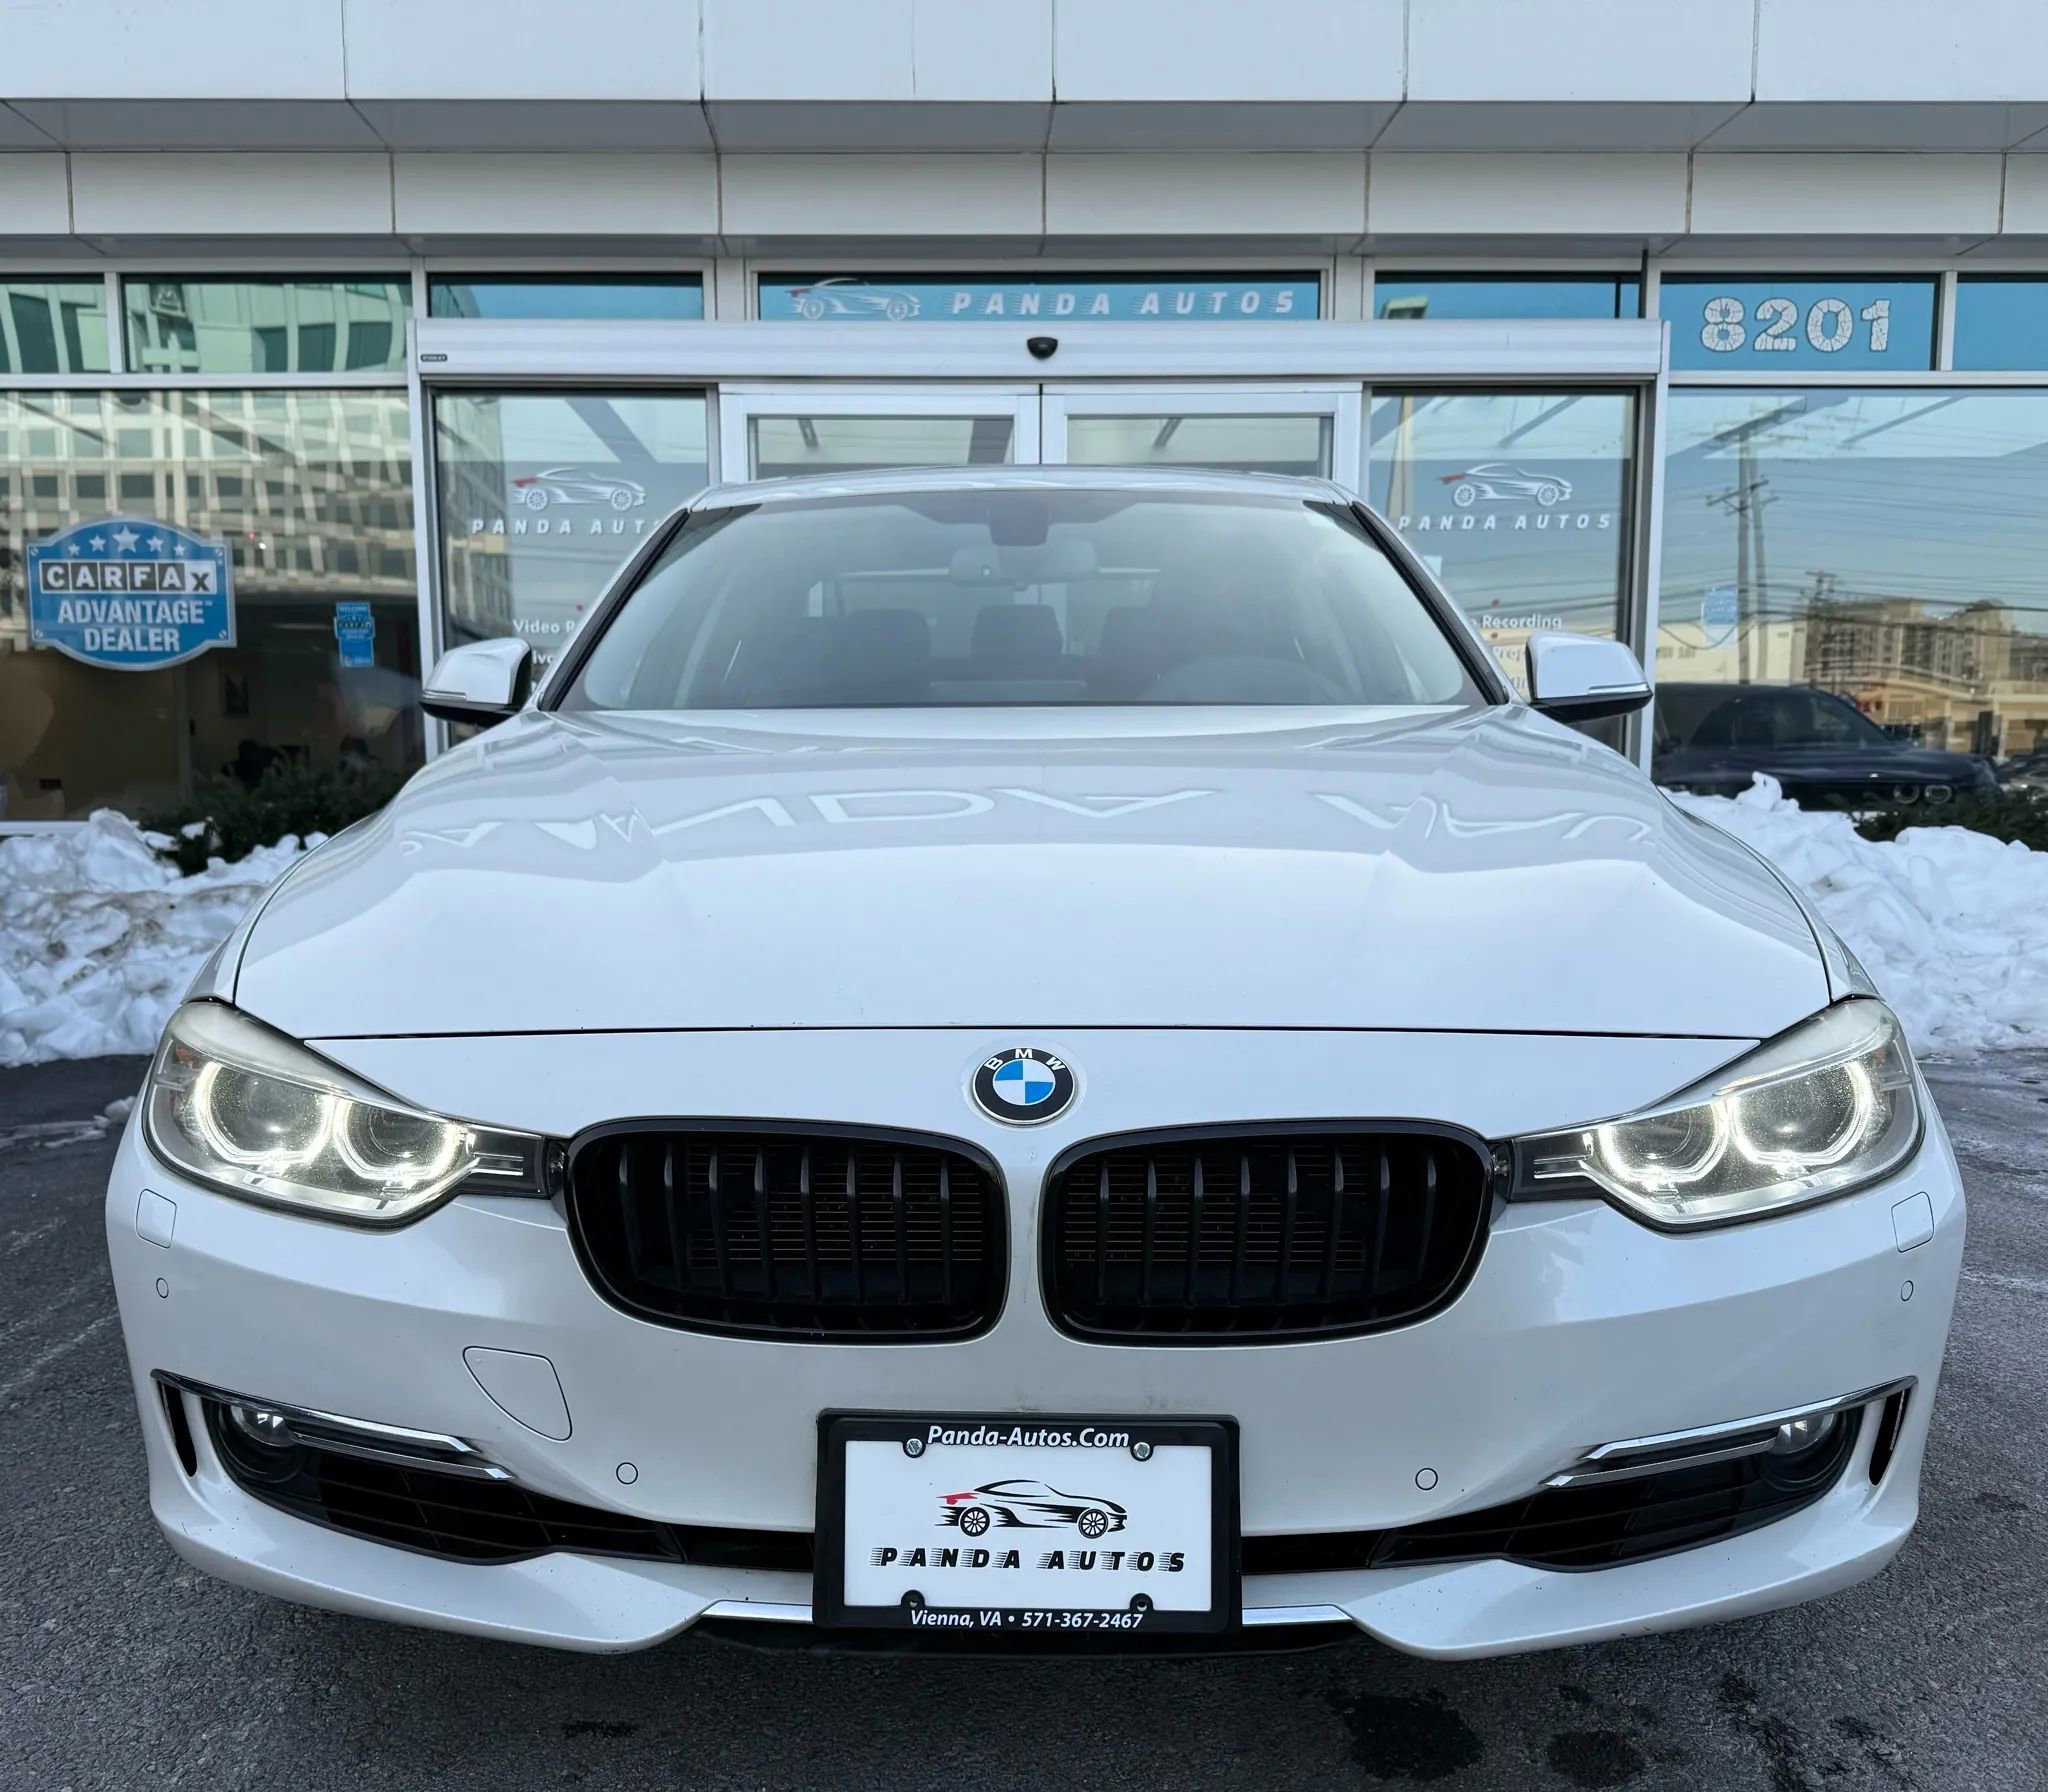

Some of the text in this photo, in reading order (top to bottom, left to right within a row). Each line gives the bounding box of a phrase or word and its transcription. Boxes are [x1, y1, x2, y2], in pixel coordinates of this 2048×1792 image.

[946, 290, 1294, 316] PANDA AUTOS
[1701, 297, 1890, 352] 8201
[471, 519, 660, 535] PANDA AUT
[1397, 513, 1612, 530] PANDA AUTOS
[46, 563, 211, 593] CARFAX
[513, 619, 560, 634] Video
[1482, 613, 1562, 630] Recording
[84, 628, 181, 651] DEALER
[984, 1047, 1066, 1071] BMW
[927, 1425, 1130, 1448] Panda-Autos.Com
[869, 1546, 1186, 1573] PANDA AUTOS
[910, 1609, 1143, 1630] Vienna, VA 571-367-2467
